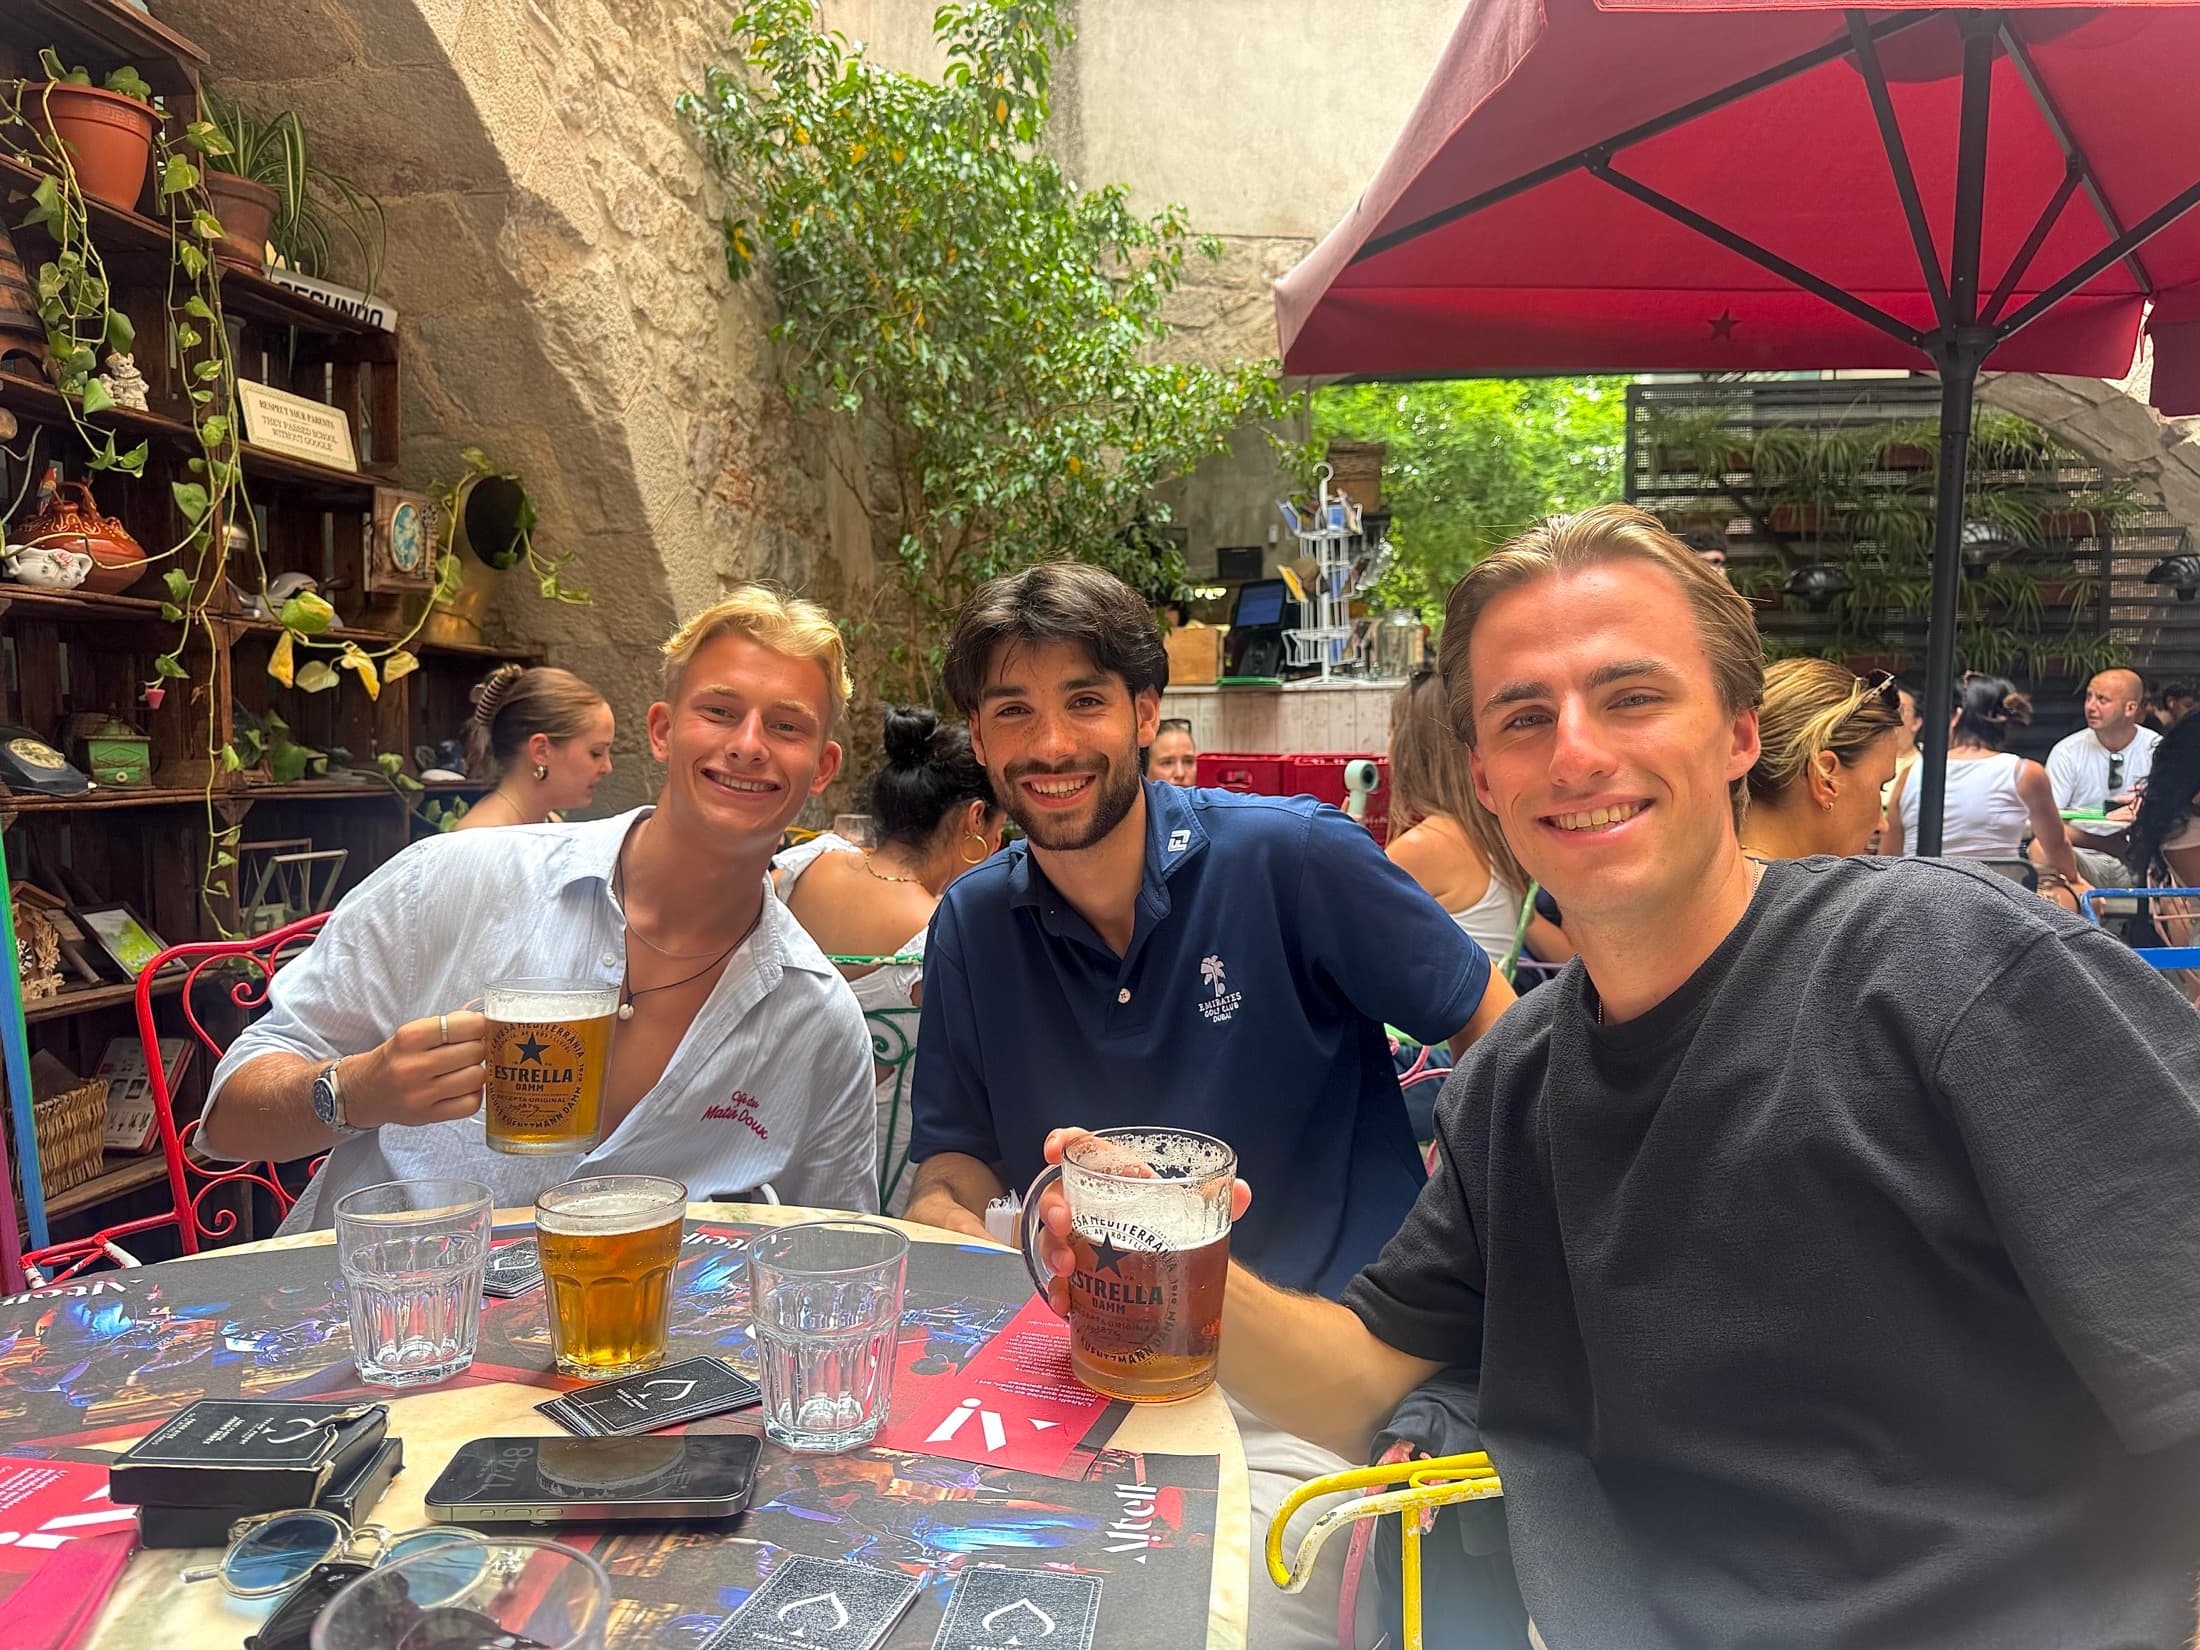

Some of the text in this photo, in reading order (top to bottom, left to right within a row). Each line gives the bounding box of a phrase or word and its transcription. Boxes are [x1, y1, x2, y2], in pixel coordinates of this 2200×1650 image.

[259, 399, 335, 429] RESPECT YOUR PARENTS
[261, 415, 283, 428] THEY
[283, 420, 311, 436] PASSED
[272, 428, 334, 451] WITHOUT GOOGLE
[1198, 991, 1242, 1012] EMIRATES
[1221, 1001, 1239, 1012] CLUB
[1213, 1011, 1232, 1023] DUBAI
[495, 1065, 573, 1083] ESTRELLA
[515, 1083, 545, 1092] DAMM
[562, 1086, 583, 1114] DAMM
[737, 1108, 768, 1140] Doux
[1092, 1297, 1126, 1315] DAMM
[481, 1447, 534, 1491] 17:48
